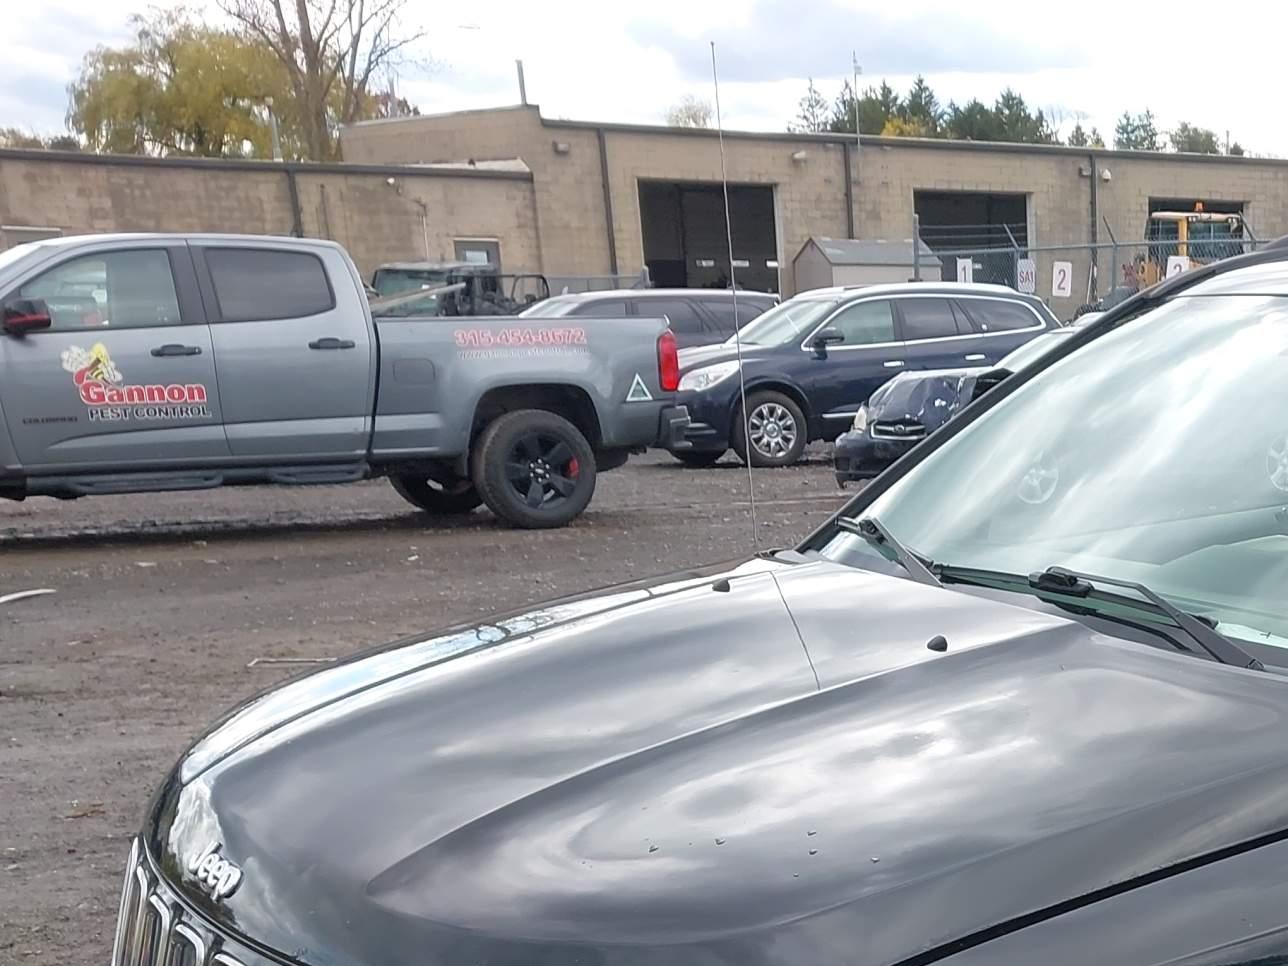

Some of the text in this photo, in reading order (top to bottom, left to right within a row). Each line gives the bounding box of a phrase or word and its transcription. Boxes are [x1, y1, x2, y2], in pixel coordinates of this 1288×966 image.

[1056, 268, 1067, 291] 2
[80, 380, 208, 406] Gannon
[88, 404, 212, 421] PEST CONTROL
[188, 840, 242, 901] Jeep
